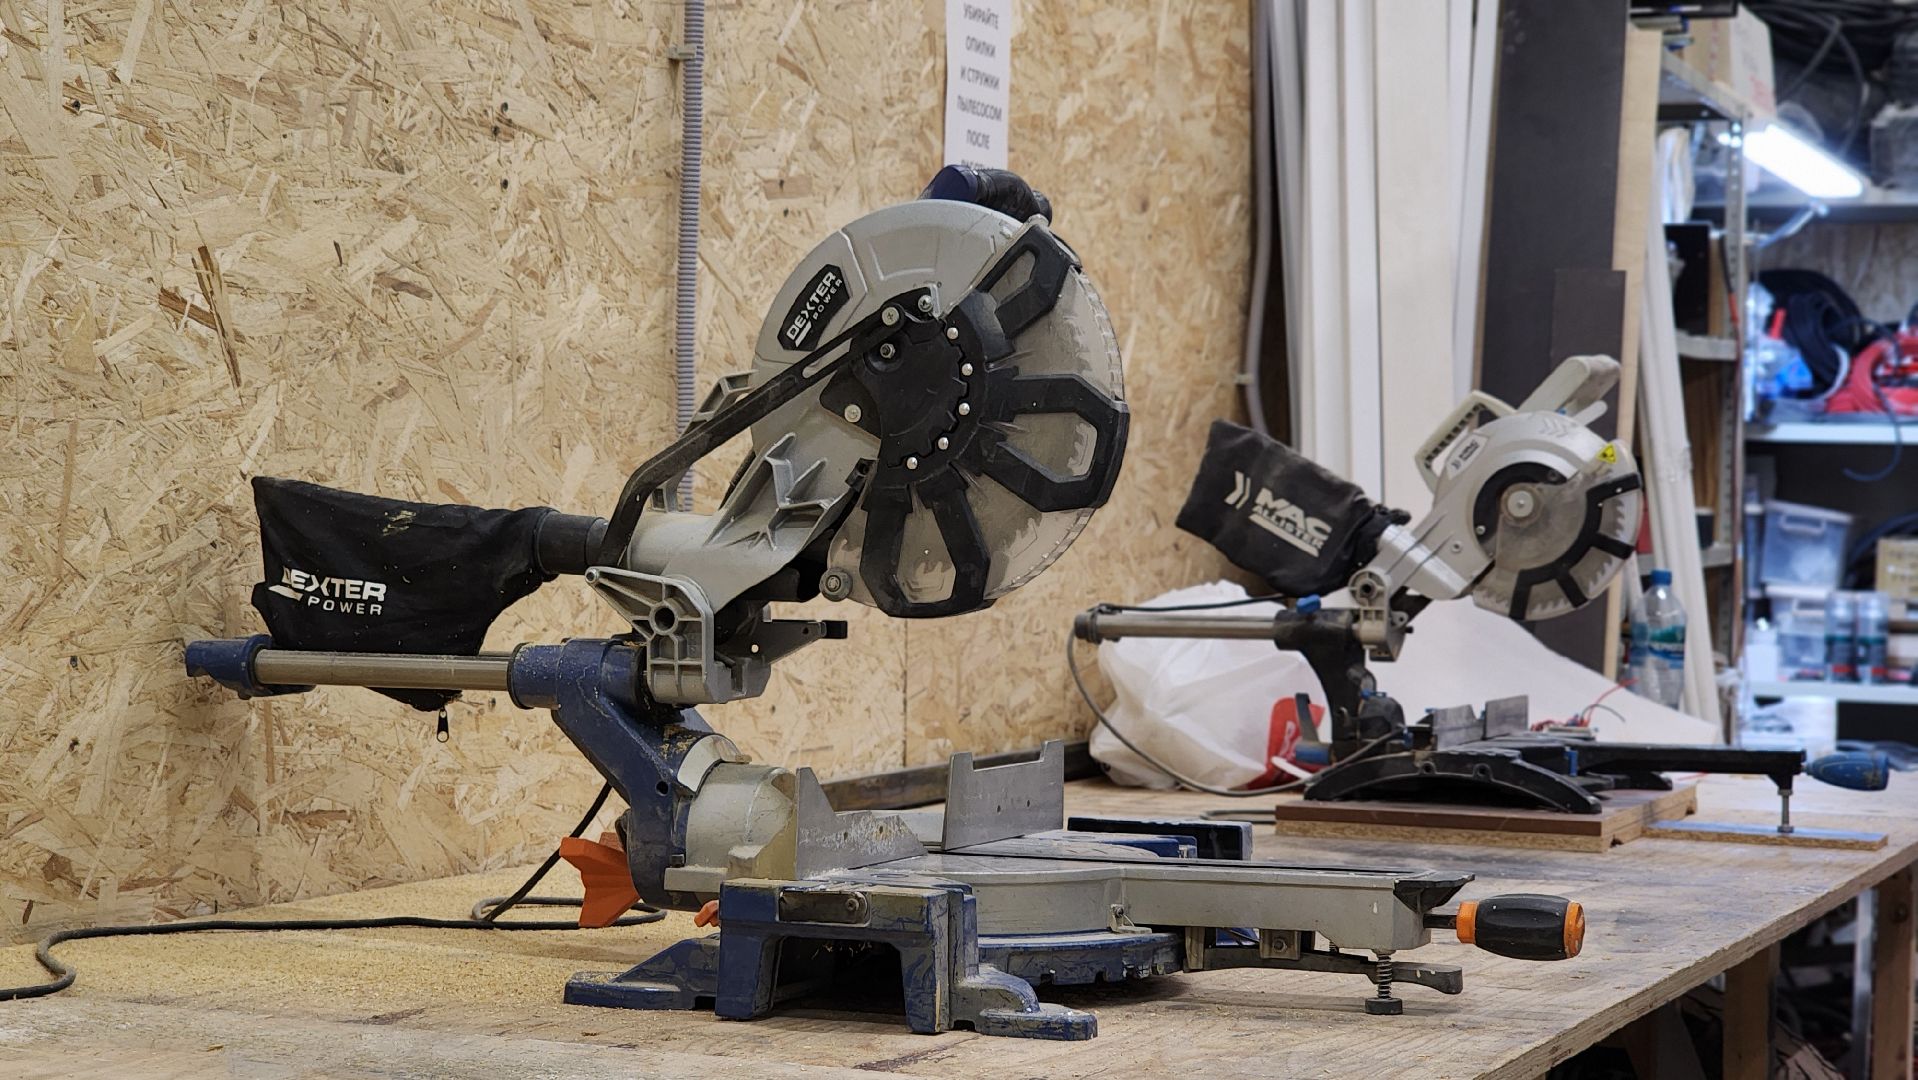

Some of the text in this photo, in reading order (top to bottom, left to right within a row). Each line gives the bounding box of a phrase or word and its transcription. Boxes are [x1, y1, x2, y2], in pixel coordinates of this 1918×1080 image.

[963, 2, 999, 30] УБИРАЙТЕ
[965, 35, 996, 58] ОПИЛКИ
[960, 66, 1000, 90] И СТРУЖКИ
[957, 95, 1002, 122] ПЫЛЕСОСОМ
[966, 128, 990, 150] ПОСЛЕ
[786, 271, 836, 340] DEXTER
[812, 278, 842, 320] POWER
[1252, 504, 1325, 550] ALLISTER
[1255, 487, 1333, 541] MAC
[307, 595, 383, 616] POWER
